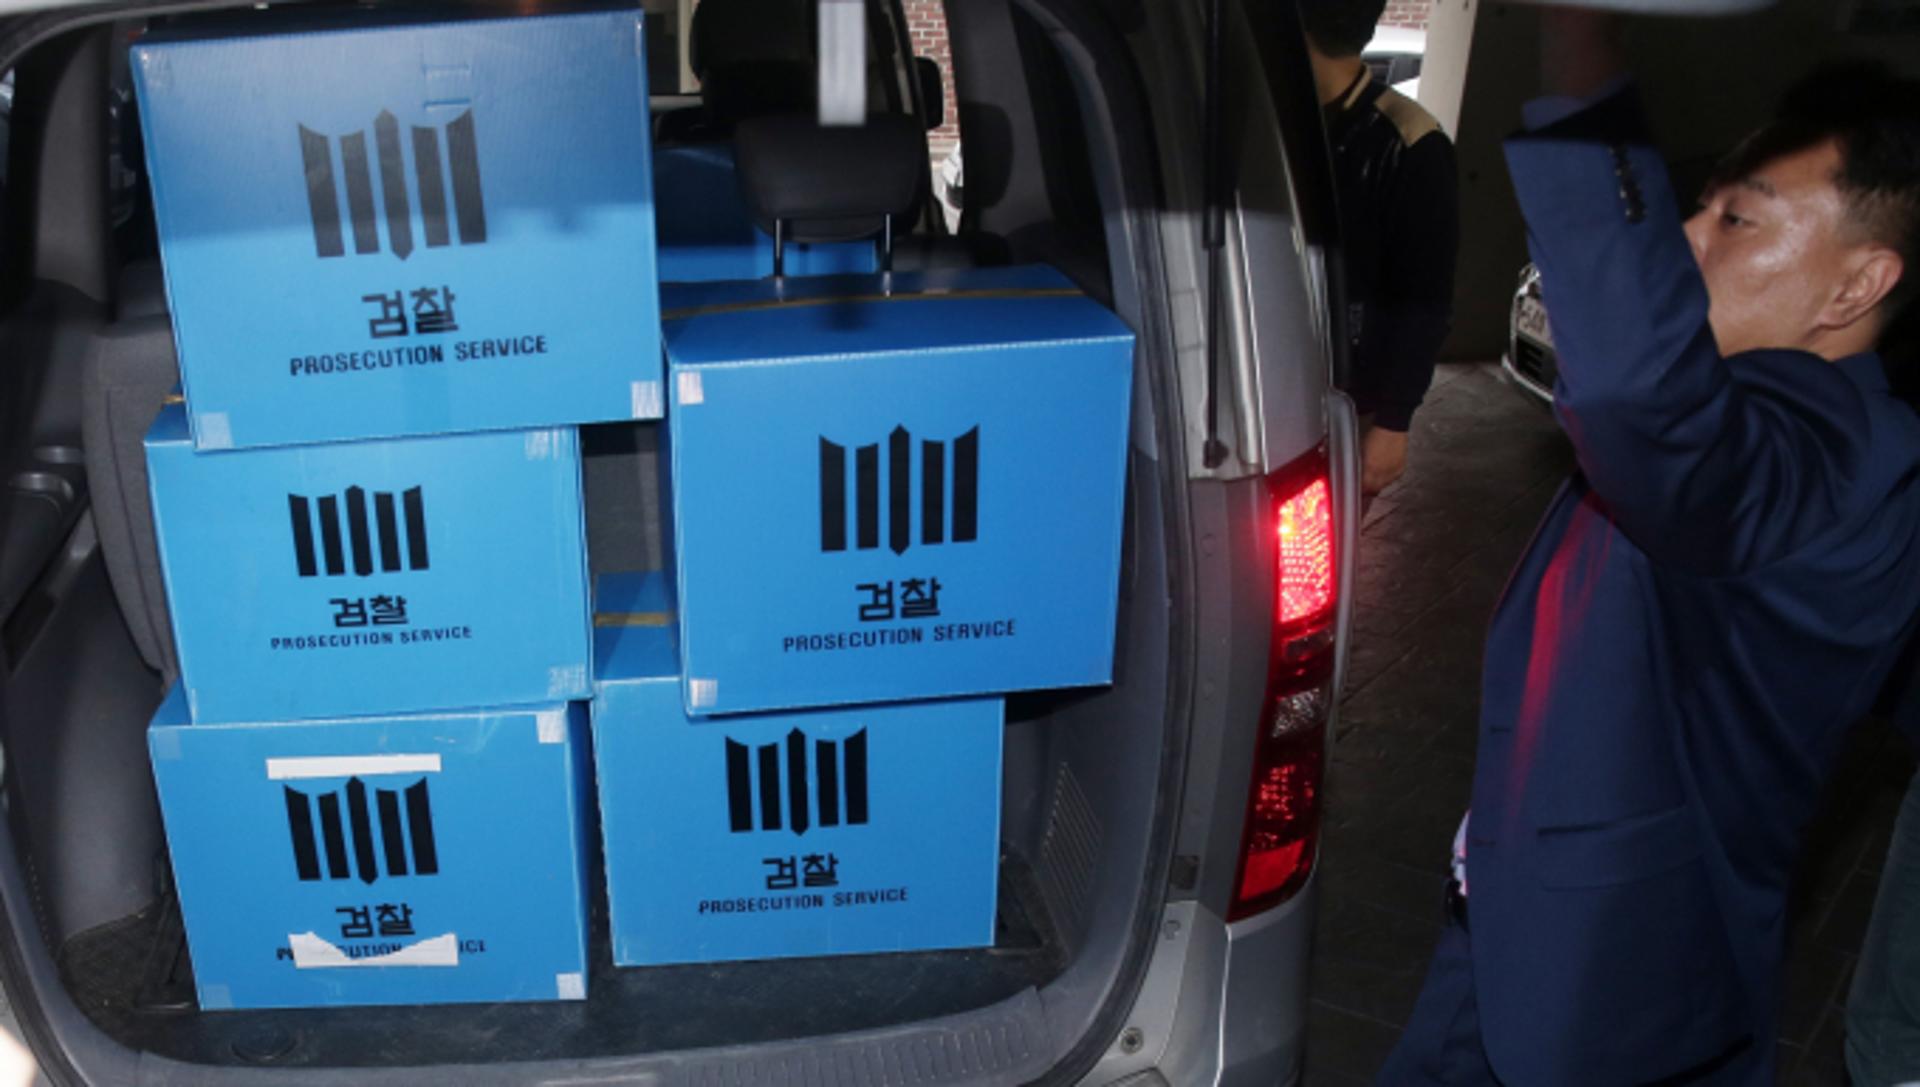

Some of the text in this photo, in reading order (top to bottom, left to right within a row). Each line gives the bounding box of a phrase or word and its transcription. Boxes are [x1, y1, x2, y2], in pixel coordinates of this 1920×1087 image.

[361, 286, 459, 339] 검찰
[290, 335, 548, 376] PROSECUTION SERVICE
[329, 595, 409, 627] 검찰
[855, 576, 942, 622] 검찰
[270, 626, 473, 650] PROSECUTION SERVICE
[783, 618, 1016, 652] PROSECUTION SERVICE
[762, 852, 839, 890] 검찰
[698, 887, 909, 915] PROSECUTION SERVICE
[335, 903, 416, 938] 검찰
